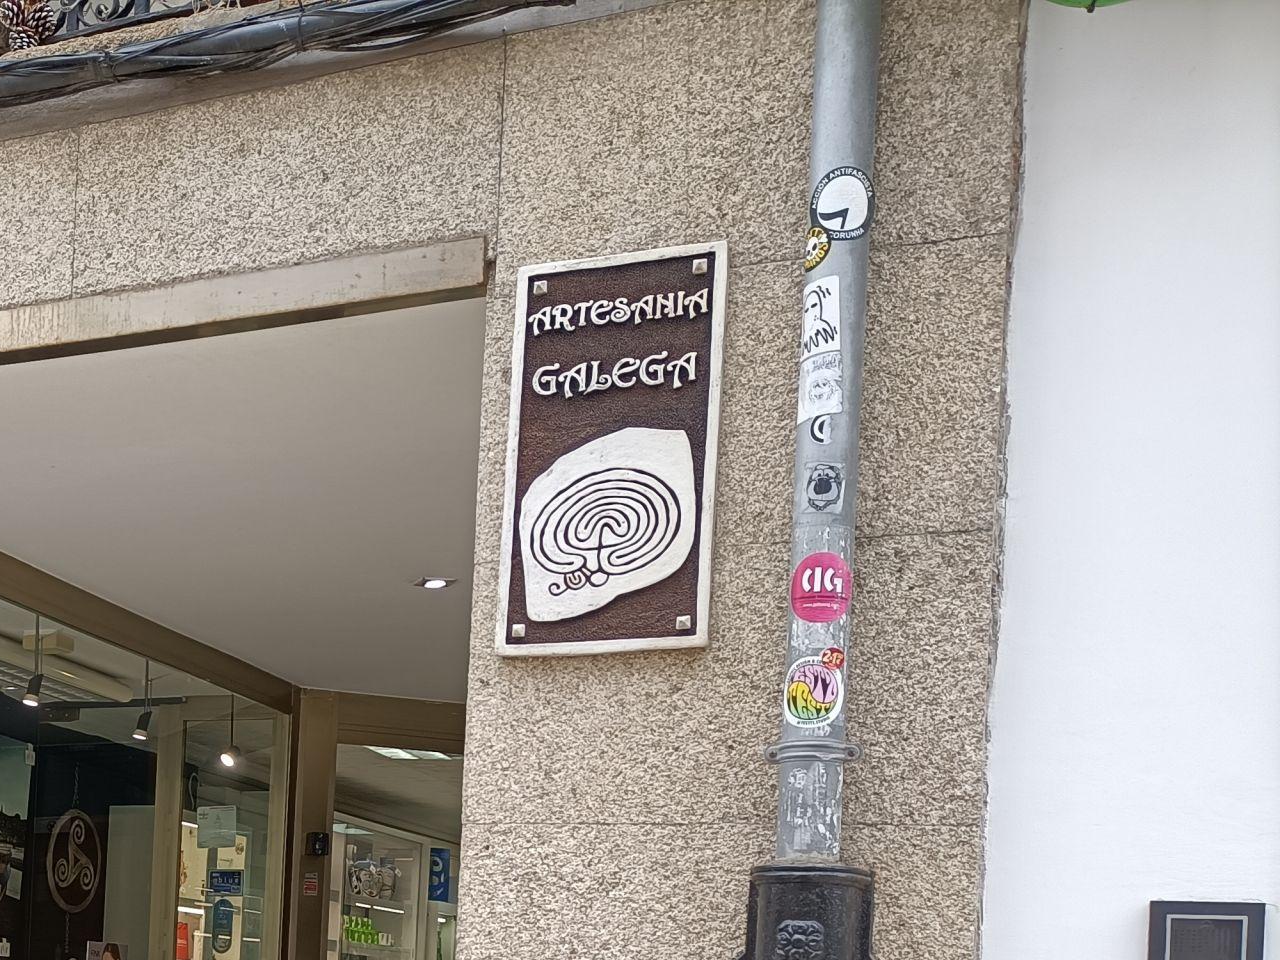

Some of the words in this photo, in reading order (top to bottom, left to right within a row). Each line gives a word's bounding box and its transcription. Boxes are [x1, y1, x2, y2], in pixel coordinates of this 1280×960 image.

[528, 288, 709, 336] ARTESANIA
[532, 351, 698, 399] GALEGA
[802, 567, 843, 592] CIG
